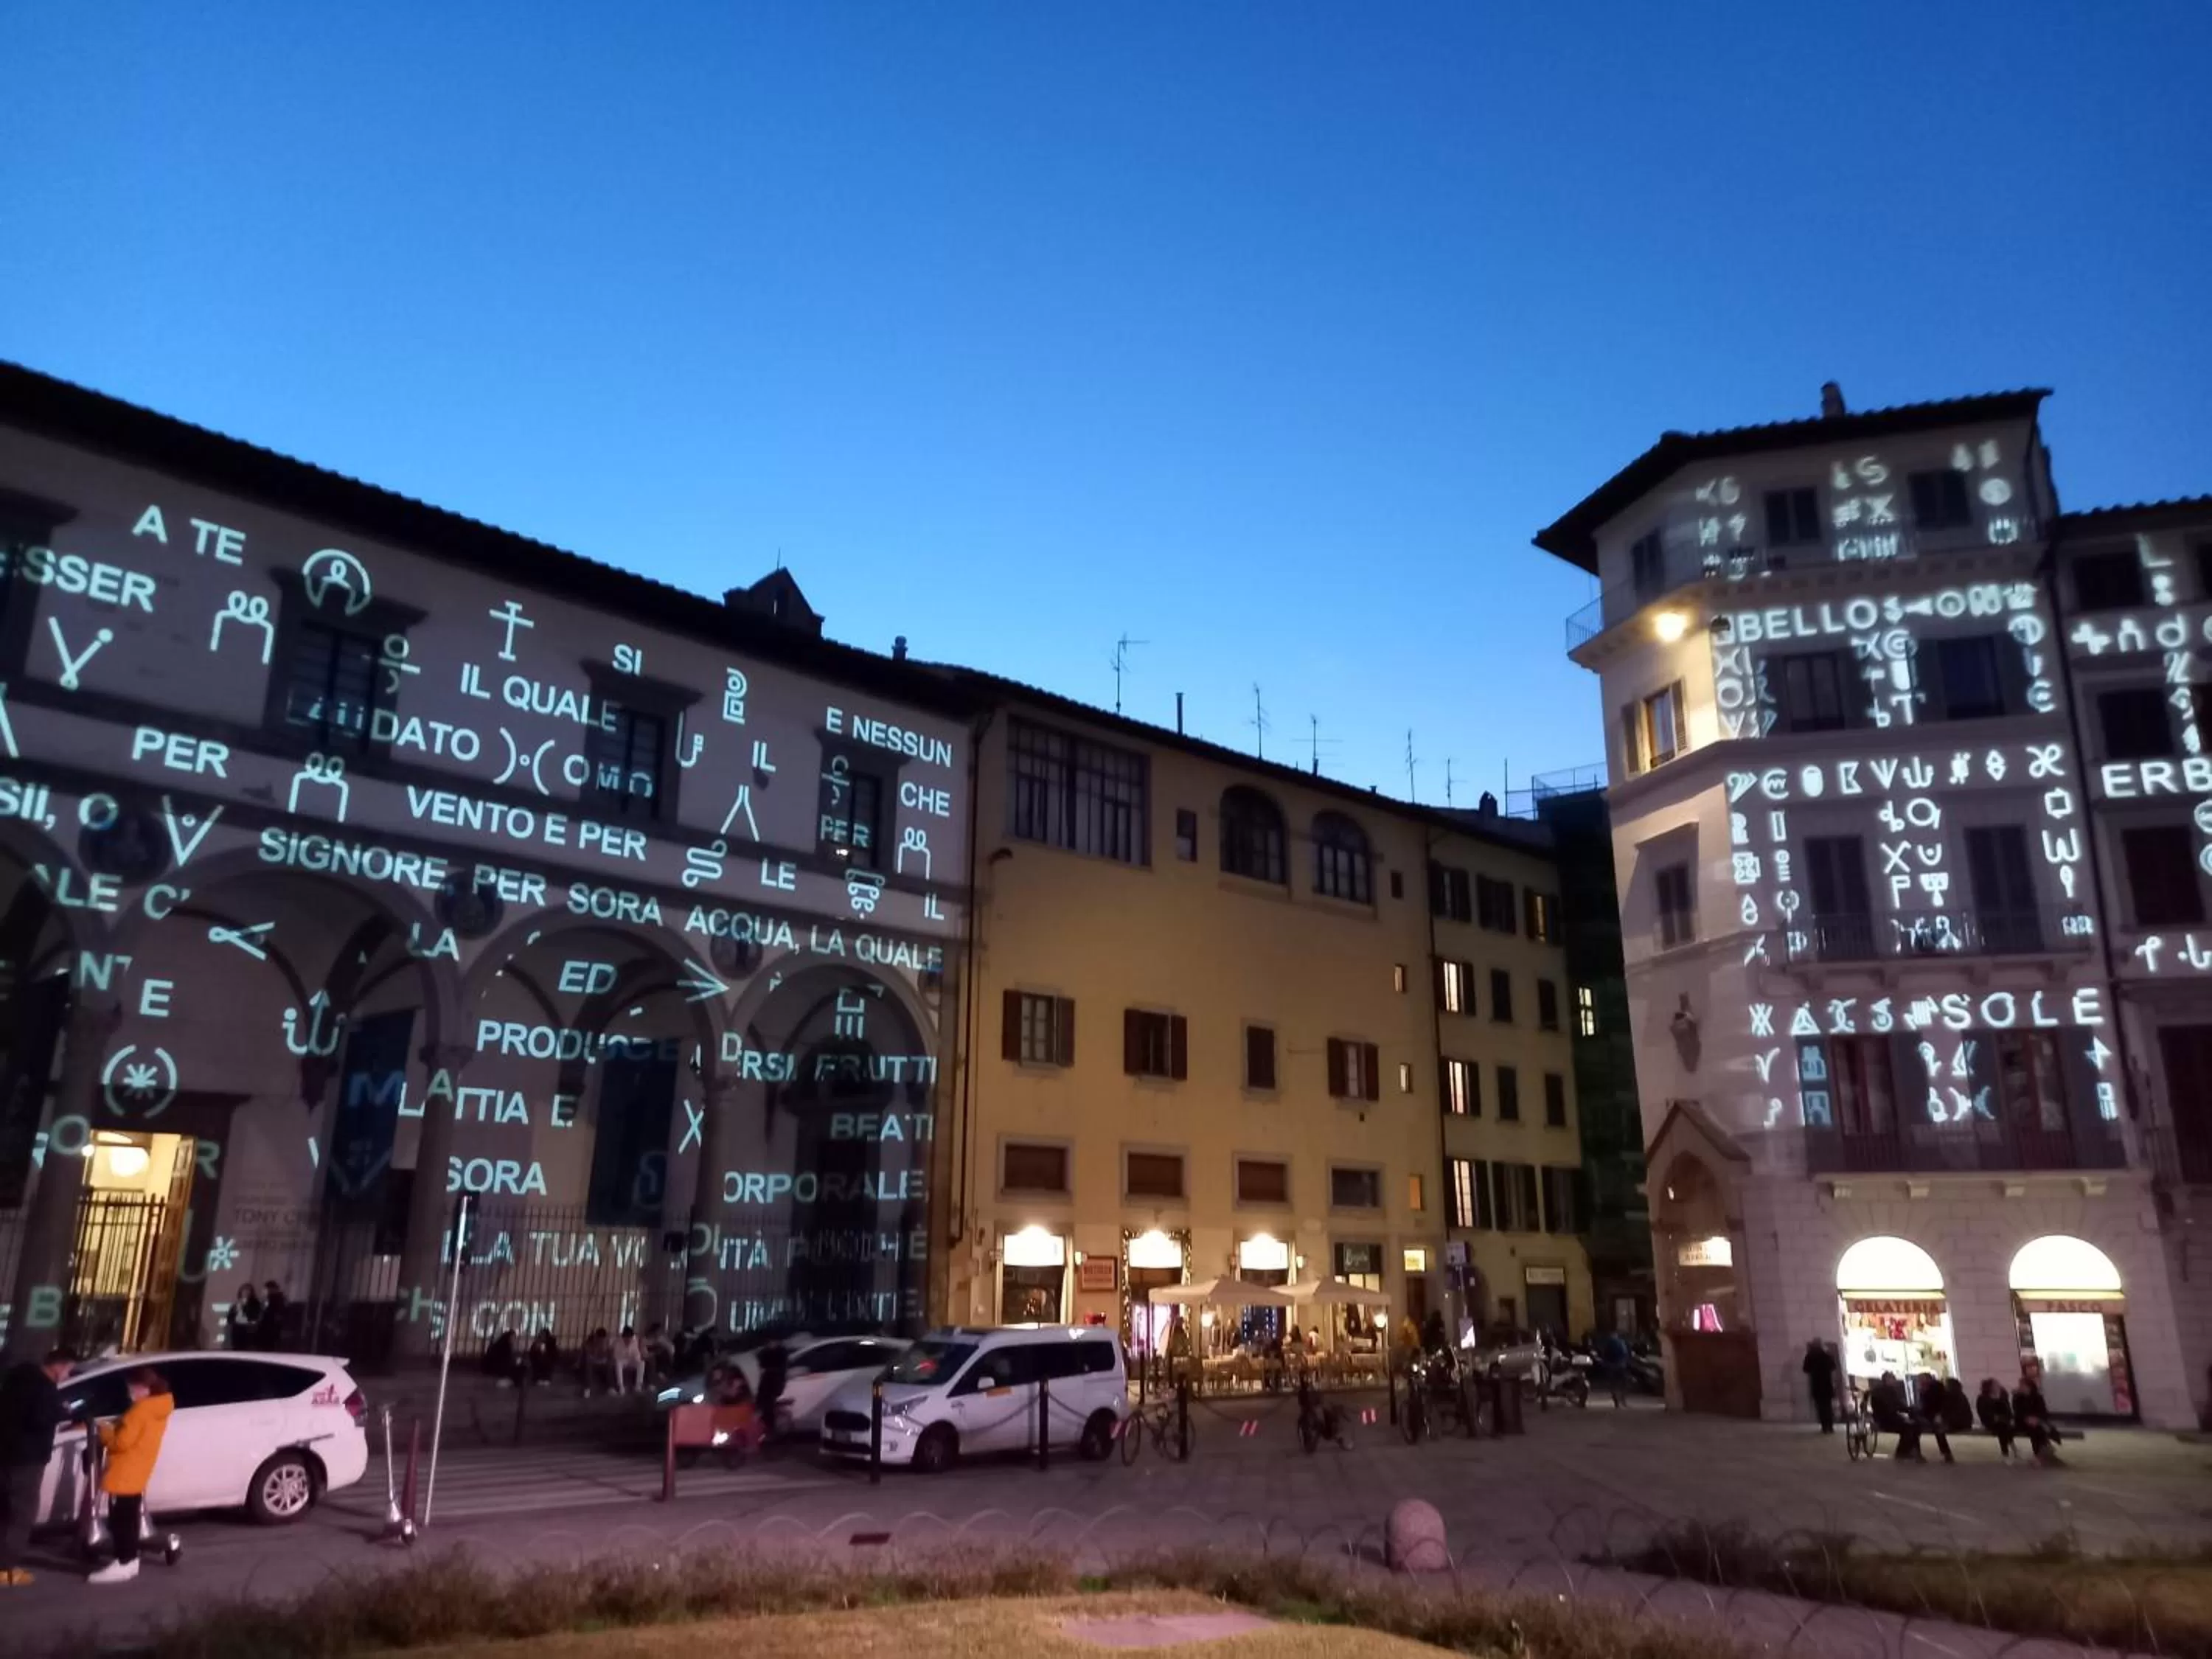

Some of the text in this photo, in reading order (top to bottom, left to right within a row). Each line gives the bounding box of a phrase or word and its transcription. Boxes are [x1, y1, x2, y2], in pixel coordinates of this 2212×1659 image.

[133, 505, 246, 565] A TE
[1737, 599, 1878, 643] BELLO
[612, 644, 642, 675] SI
[460, 663, 618, 732] IL QUALE
[133, 727, 229, 777] PER
[752, 741, 776, 772] IL
[826, 706, 952, 768] E NESSUN
[2101, 758, 2212, 798] ERB
[900, 782, 950, 817] CHE
[407, 785, 647, 861] VENTO E PER
[821, 814, 871, 848] PER
[760, 858, 796, 891] LE
[472, 863, 547, 907] PER
[566, 883, 663, 927] SORA
[684, 905, 801, 956] ACQUA,
[810, 925, 846, 957] LA
[855, 933, 945, 973] QUALE
[924, 893, 945, 921] IL
[407, 922, 460, 962] LA
[559, 960, 616, 993] ED
[139, 979, 174, 1017] E
[1941, 988, 2104, 1030] SOLE
[446, 1155, 547, 1195] SORA
